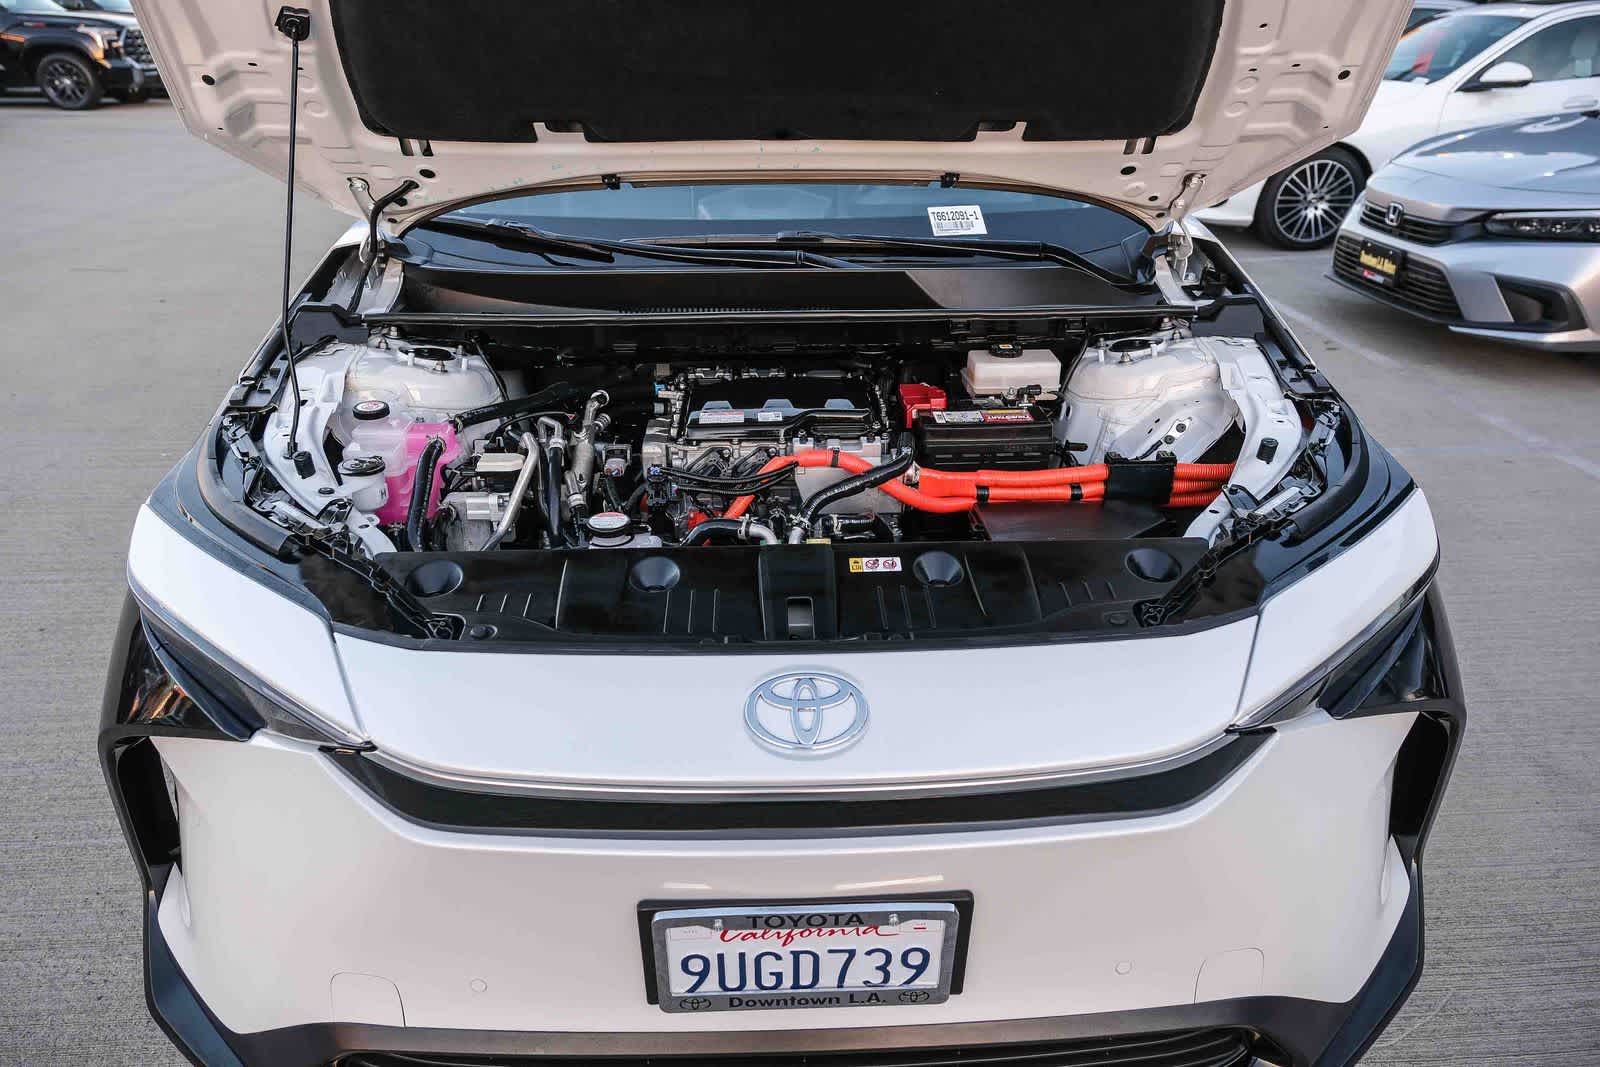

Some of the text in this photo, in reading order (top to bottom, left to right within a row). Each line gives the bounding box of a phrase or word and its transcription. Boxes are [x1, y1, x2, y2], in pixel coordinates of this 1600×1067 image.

[930, 210, 980, 221] T6612091-1
[745, 913, 865, 929] TOYOTA
[720, 924, 900, 947] California
[680, 947, 931, 994] 9UGD739
[729, 992, 887, 1009] Downtown L.A.
